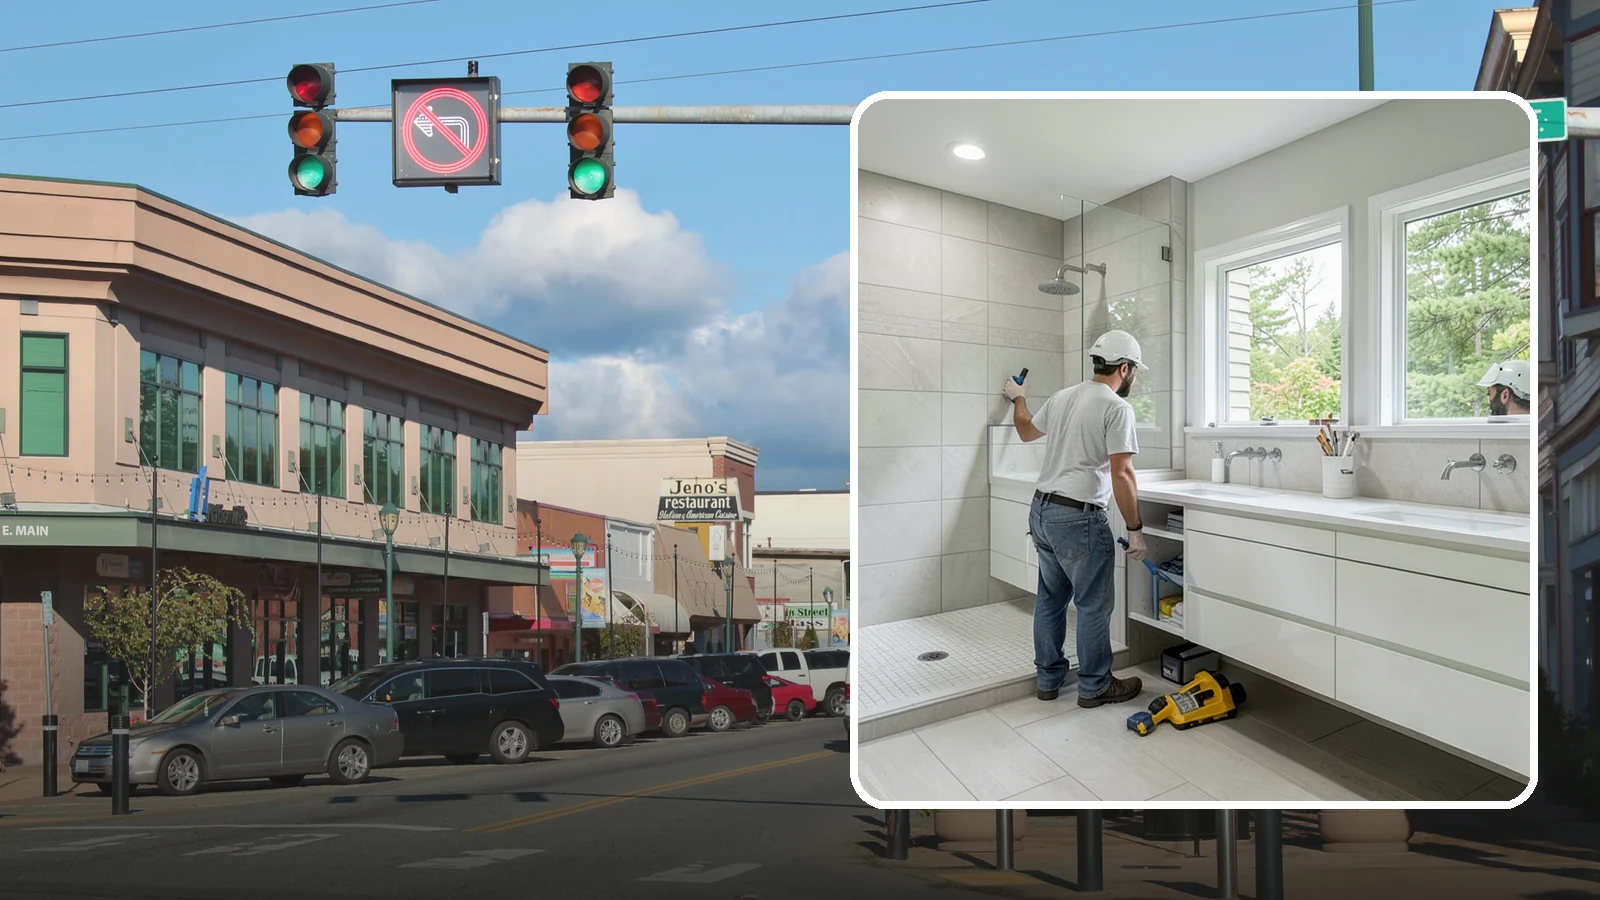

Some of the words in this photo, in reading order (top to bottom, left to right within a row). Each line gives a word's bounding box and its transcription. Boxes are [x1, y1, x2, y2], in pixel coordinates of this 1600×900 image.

[670, 480, 727, 494] Jeno's
[665, 496, 731, 509] restaurant
[658, 510, 681, 519] Italian
[686, 509, 714, 519] American
[714, 509, 737, 519] Cuisine
[2, 525, 13, 536] E.
[15, 525, 49, 536] MAIN
[797, 607, 829, 617] Street
[790, 619, 823, 627] lass
